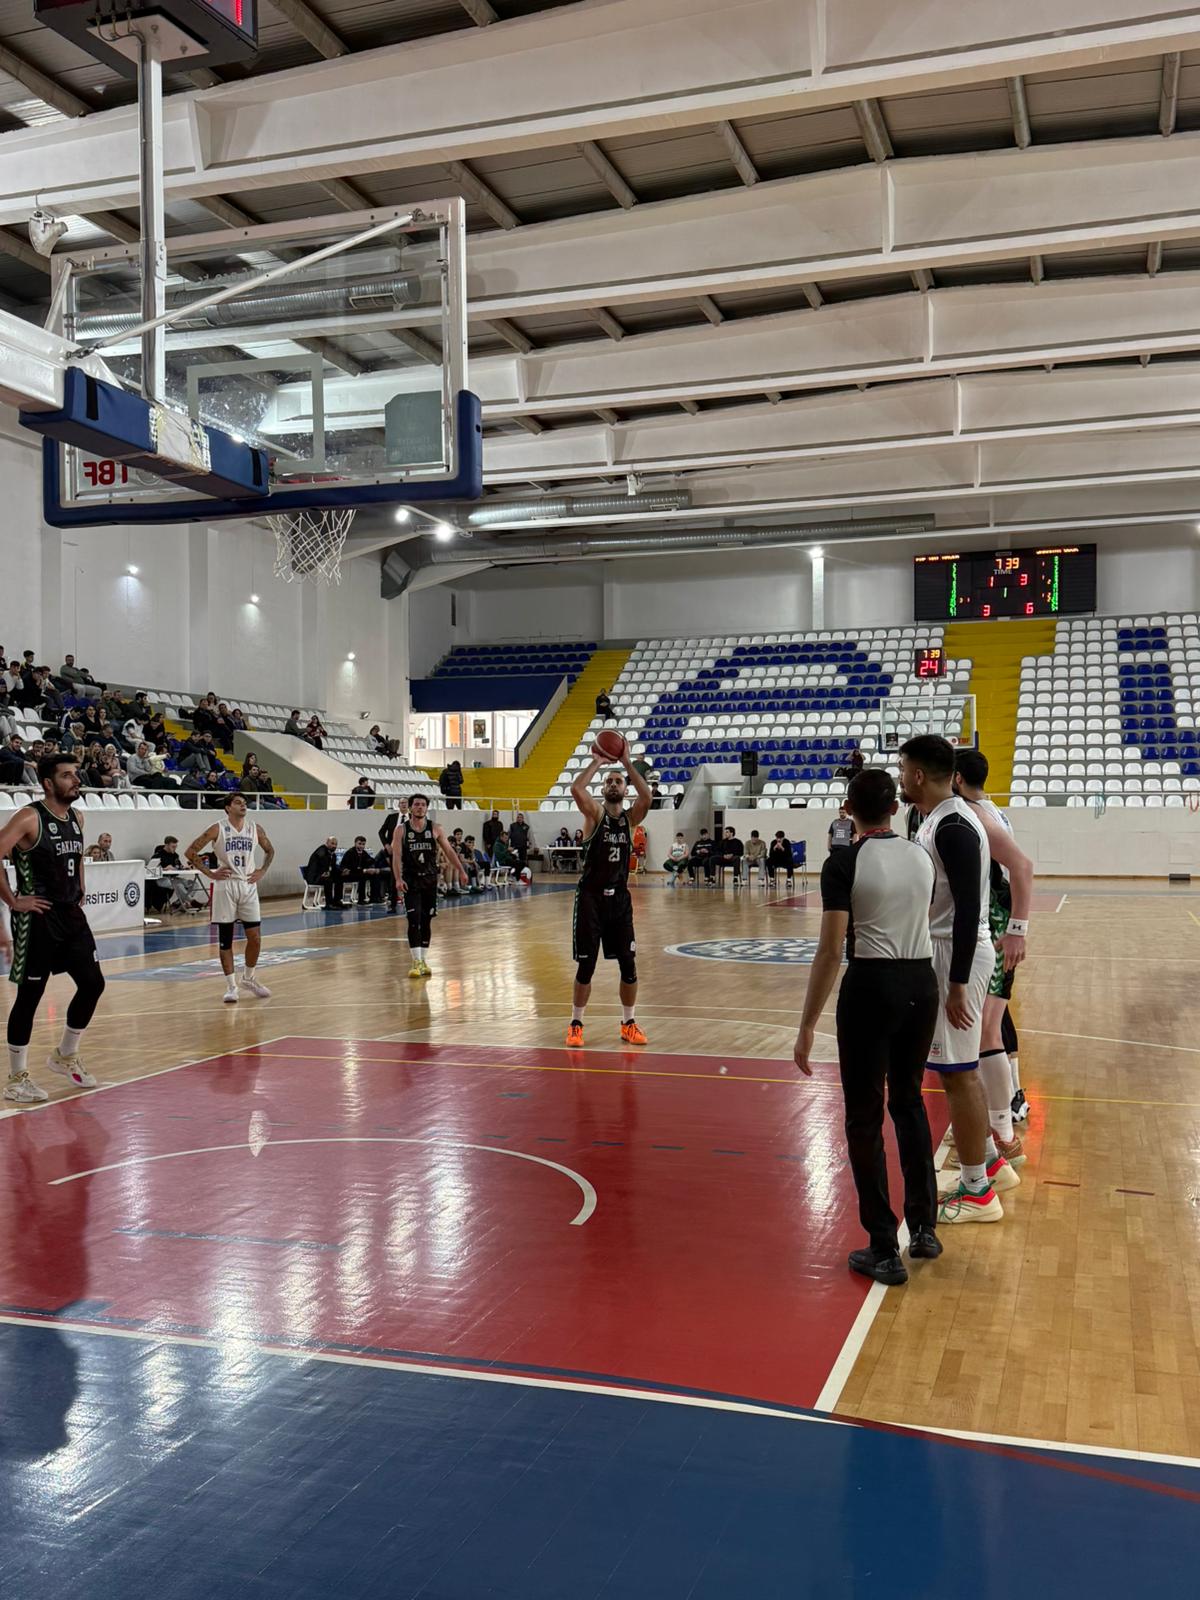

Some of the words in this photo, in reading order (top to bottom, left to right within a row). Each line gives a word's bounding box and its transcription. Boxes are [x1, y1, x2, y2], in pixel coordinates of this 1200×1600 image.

[1020, 573, 1028, 586] 3
[983, 604, 991, 617] 3
[1026, 602, 1034, 614] 6
[920, 660, 938, 676] 24
[234, 856, 245, 867] 61
[418, 852, 425, 864] 4
[67, 858, 75, 877] 9
